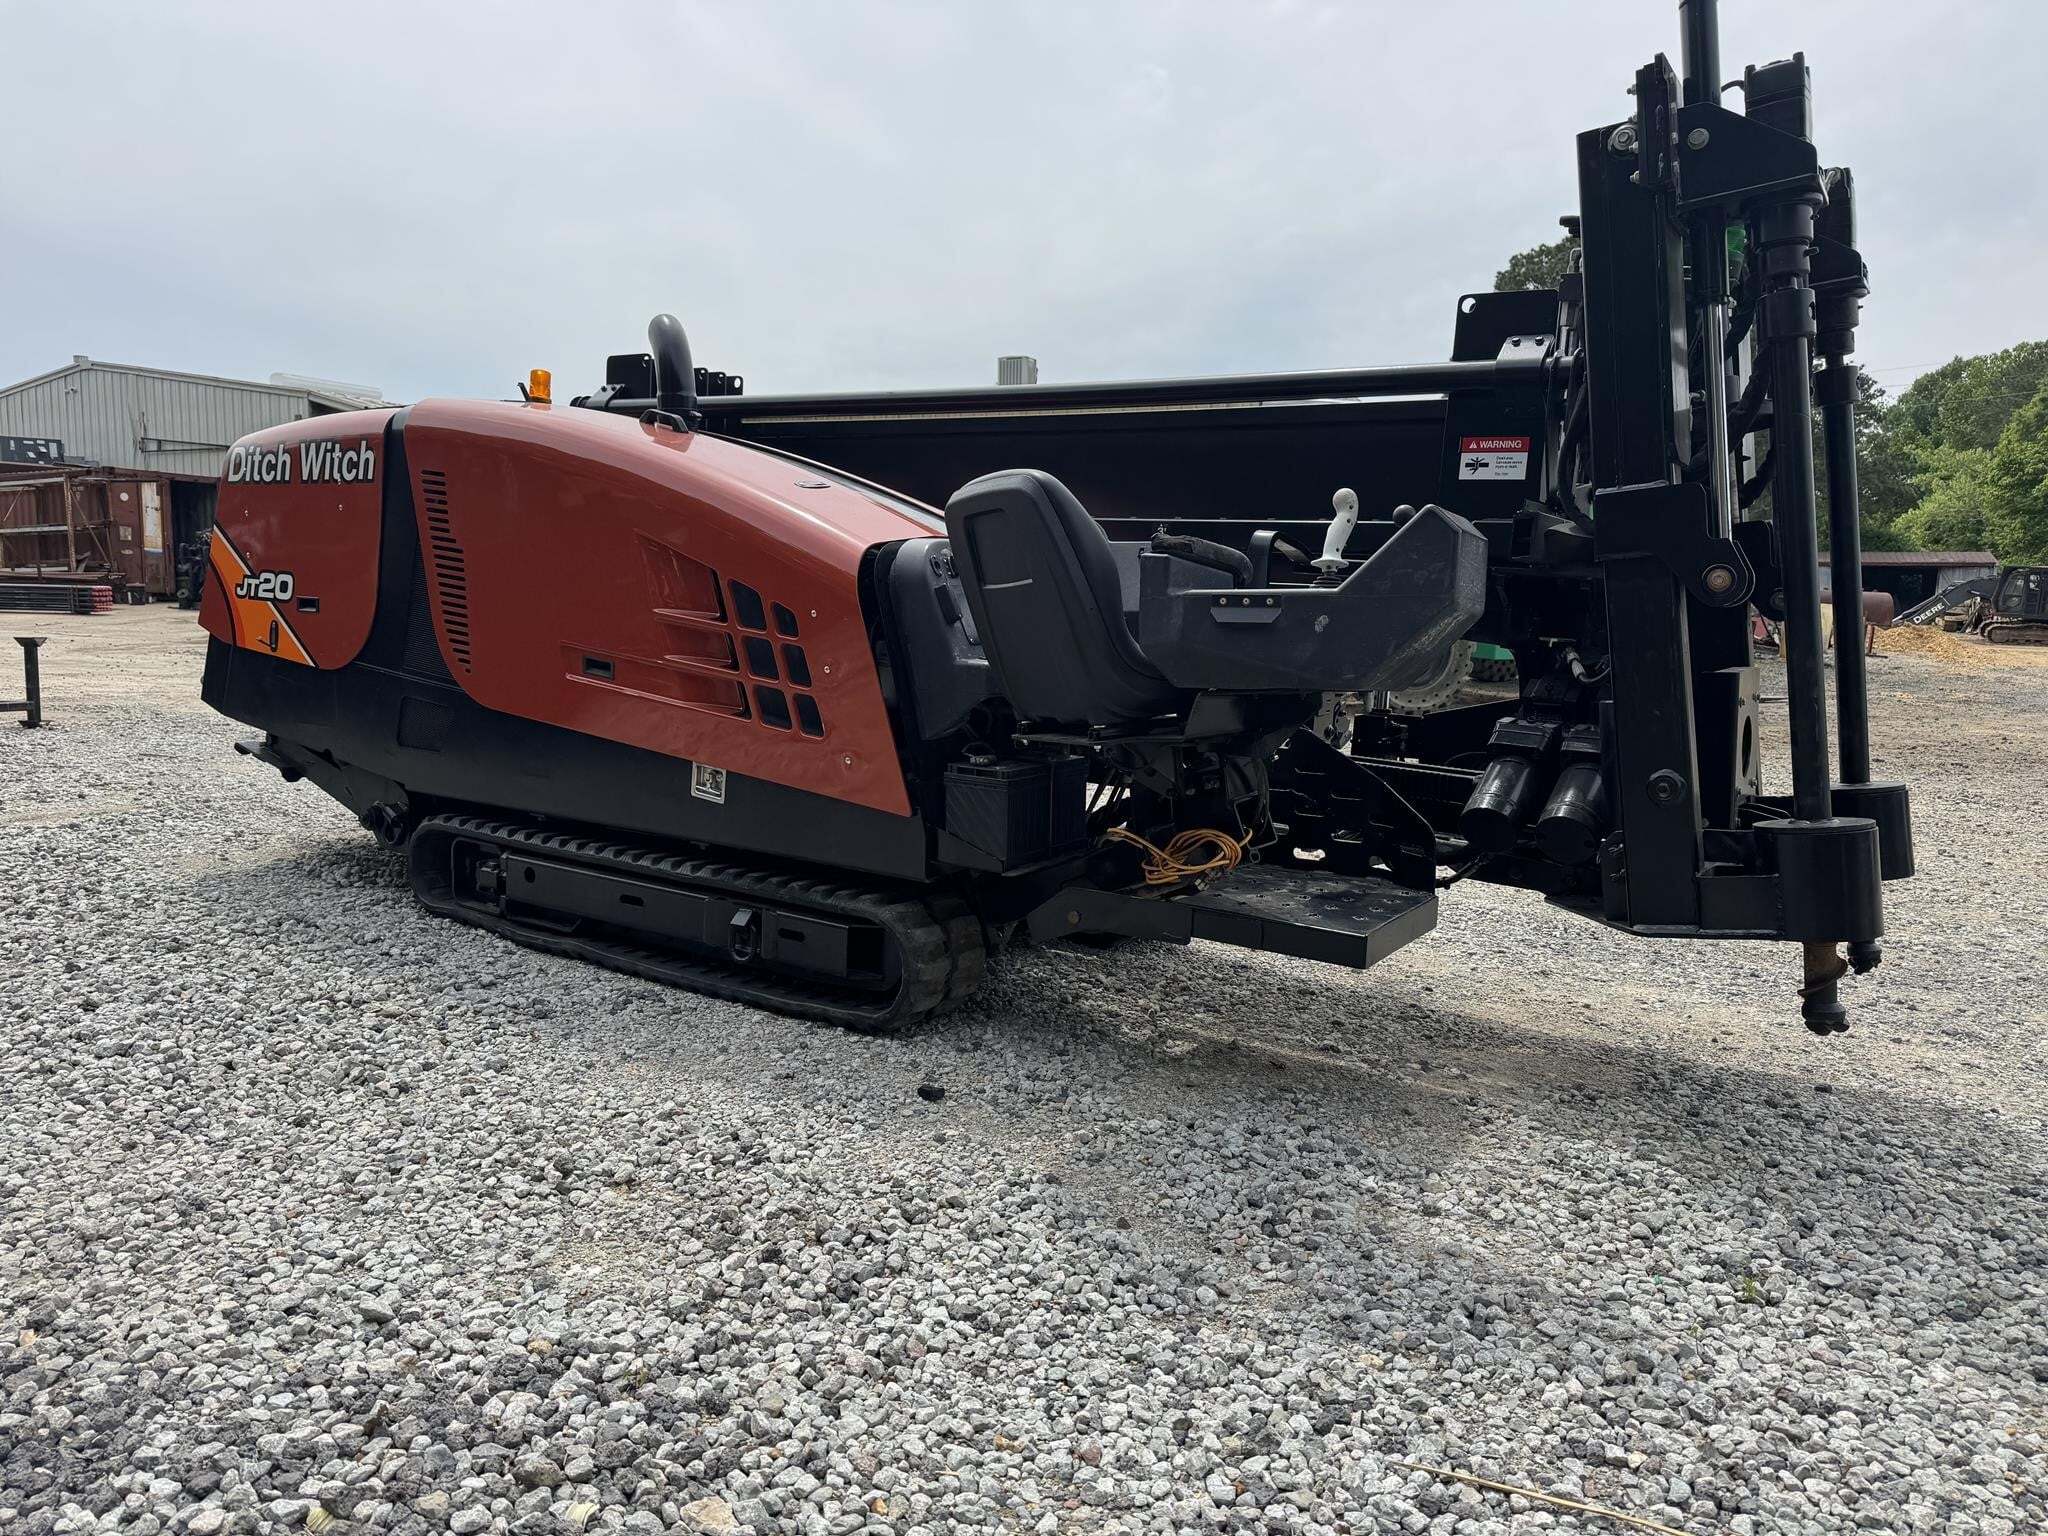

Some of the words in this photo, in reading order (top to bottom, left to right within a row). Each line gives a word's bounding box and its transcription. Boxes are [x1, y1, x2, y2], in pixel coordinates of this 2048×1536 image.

[1479, 440, 1522, 449] WARNING
[227, 443, 292, 483] Ditch
[299, 440, 375, 482] Witch
[235, 572, 294, 601] JT20
[1913, 602, 1946, 625] DEERE
